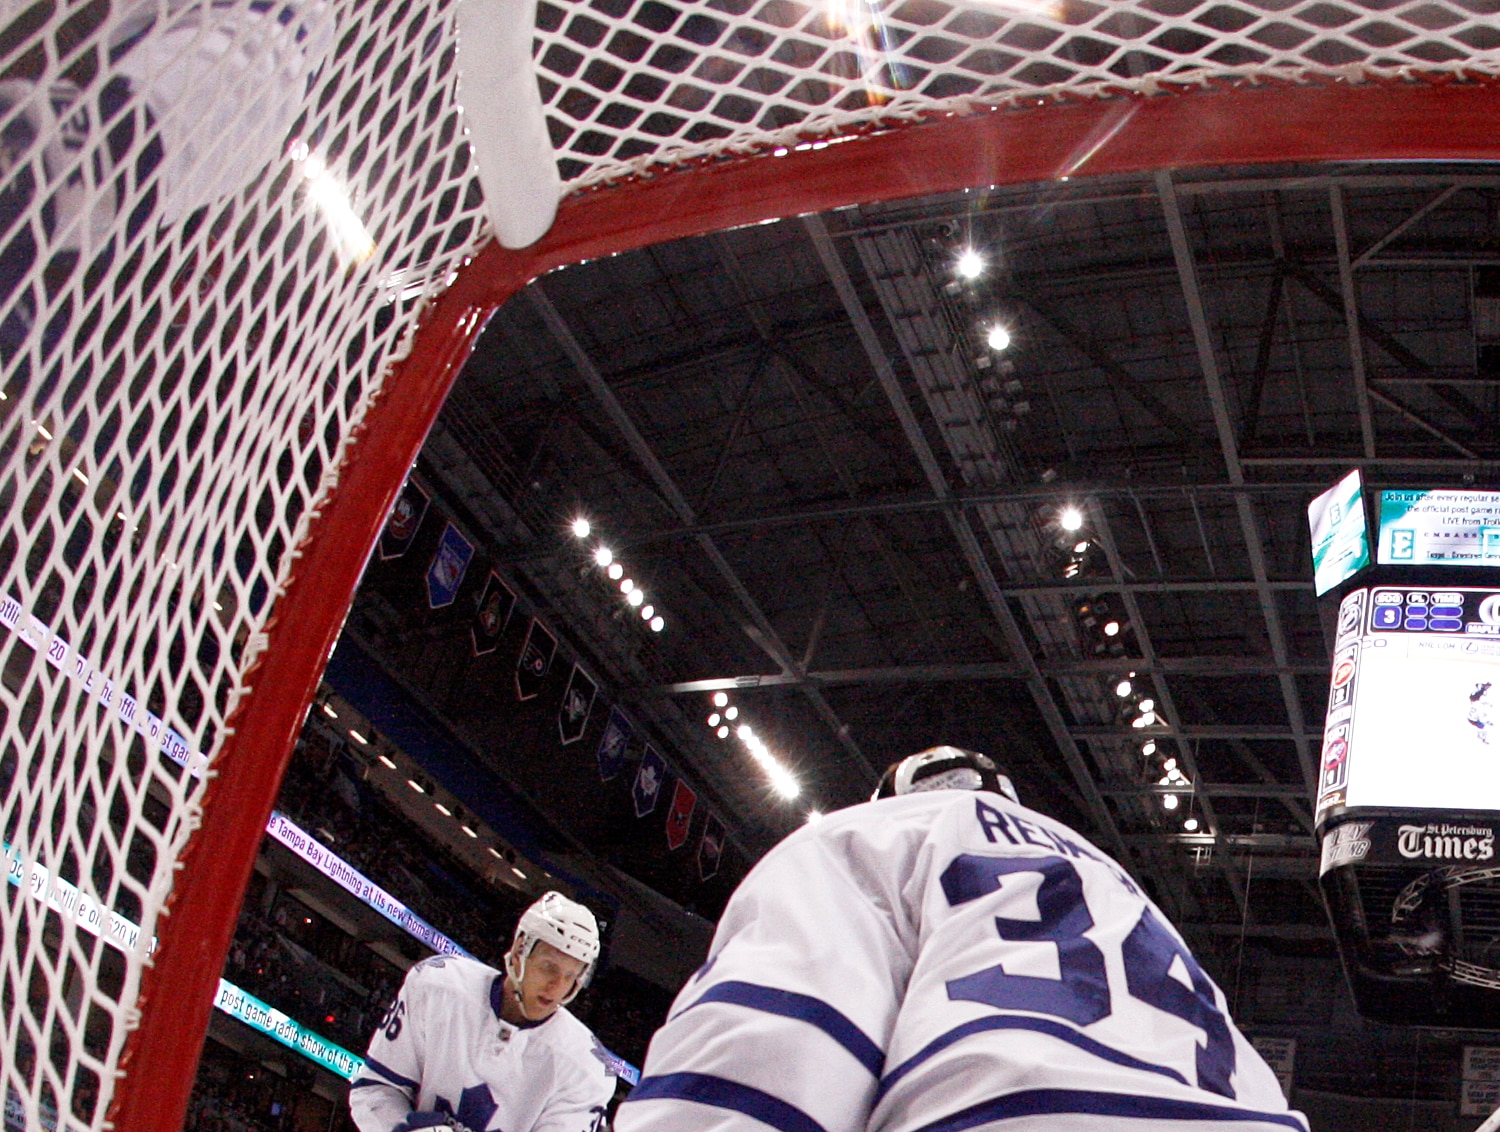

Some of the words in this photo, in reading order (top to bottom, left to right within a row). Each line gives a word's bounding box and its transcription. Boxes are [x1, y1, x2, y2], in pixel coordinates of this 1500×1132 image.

[1437, 495, 1458, 504] every
[1460, 494, 1489, 504] regular
[1423, 505, 1450, 514] official
[1452, 506, 1469, 515] post
[1471, 507, 1493, 516] game
[1442, 517, 1461, 526] LIVE
[1462, 517, 1481, 526] from
[1383, 609, 1396, 624] 3
[1440, 823, 1493, 838] Petersburg
[1398, 824, 1496, 861] Times
[277, 818, 306, 851] Tampa
[306, 841, 323, 866] Bay
[323, 854, 363, 894] Lightning
[362, 885, 374, 901] at
[374, 890, 387, 909] its
[386, 903, 405, 922] new
[406, 913, 430, 940] home
[431, 931, 450, 954] LIVE
[939, 852, 1238, 1100] 34
[220, 989, 245, 1012] post
[245, 1003, 273, 1028] game
[274, 1020, 300, 1043] radio
[300, 1033, 326, 1058] show
[327, 1049, 338, 1065] of
[338, 1054, 354, 1074] the
